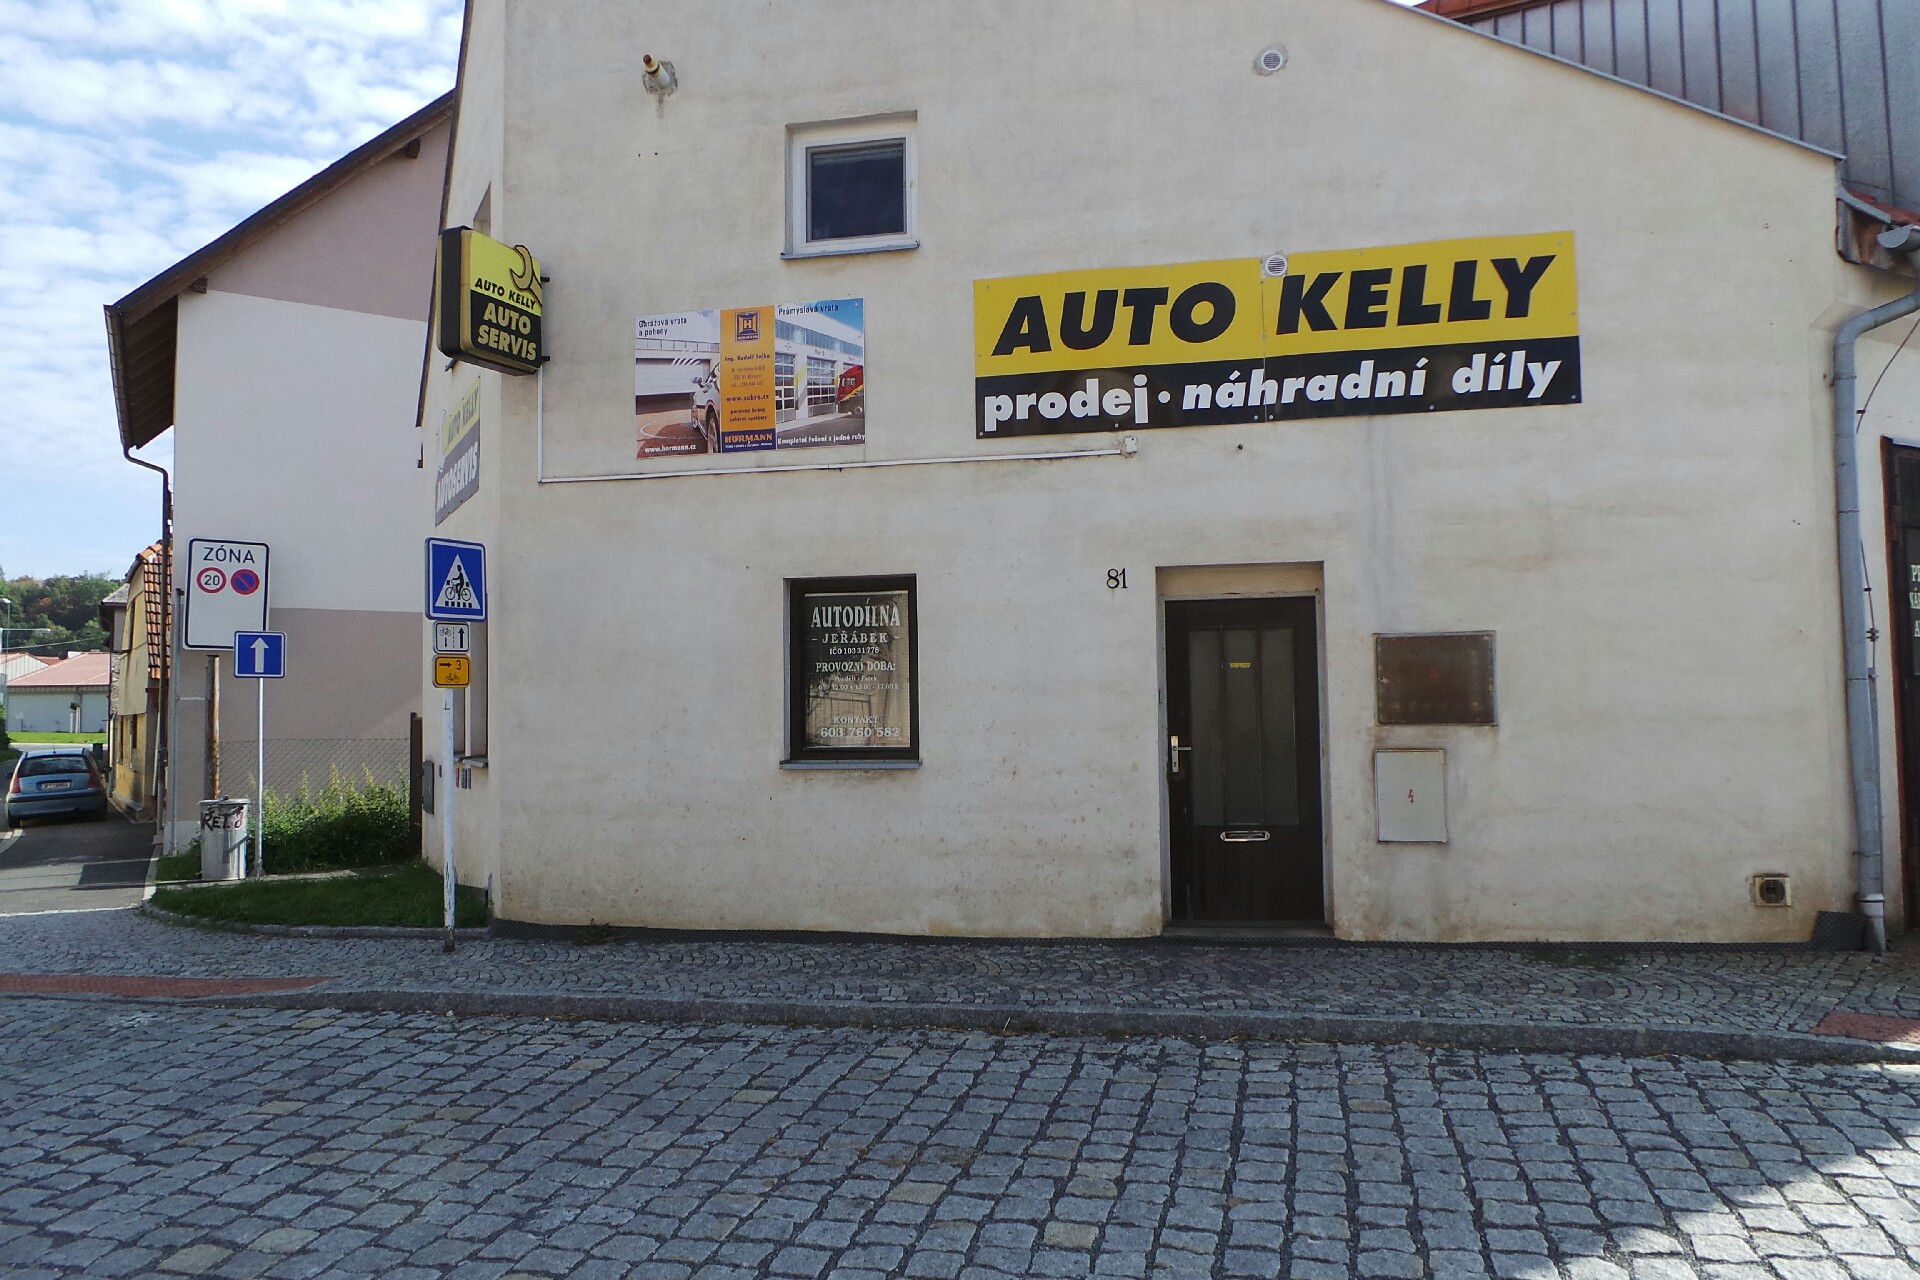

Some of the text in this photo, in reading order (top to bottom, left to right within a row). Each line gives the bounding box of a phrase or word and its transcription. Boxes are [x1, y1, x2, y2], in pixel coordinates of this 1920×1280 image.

[474, 277, 536, 310] AUTO KELLY
[778, 304, 839, 315] Průmyslová vrata
[991, 255, 1556, 356] AUTO KELLY
[483, 302, 531, 335] AUTO
[639, 317, 687, 328] Garážová vrata
[477, 324, 537, 361] SERVIS
[645, 328, 668, 337] pohony
[984, 350, 1562, 432] prodej náhradní díly
[462, 386, 479, 428] KELLY
[436, 441, 478, 512] AUTOSERVIS
[203, 545, 255, 564] ZÓNA
[204, 574, 220, 586] 20
[1106, 568, 1128, 589] 81
[811, 598, 900, 628] AUTODÍLNA
[822, 630, 888, 644] JEŘÁBEK
[456, 660, 462, 671] 3
[816, 658, 896, 672] PROVOZNÍ DOBA:
[821, 727, 844, 738] 603
[876, 727, 900, 737] 582
